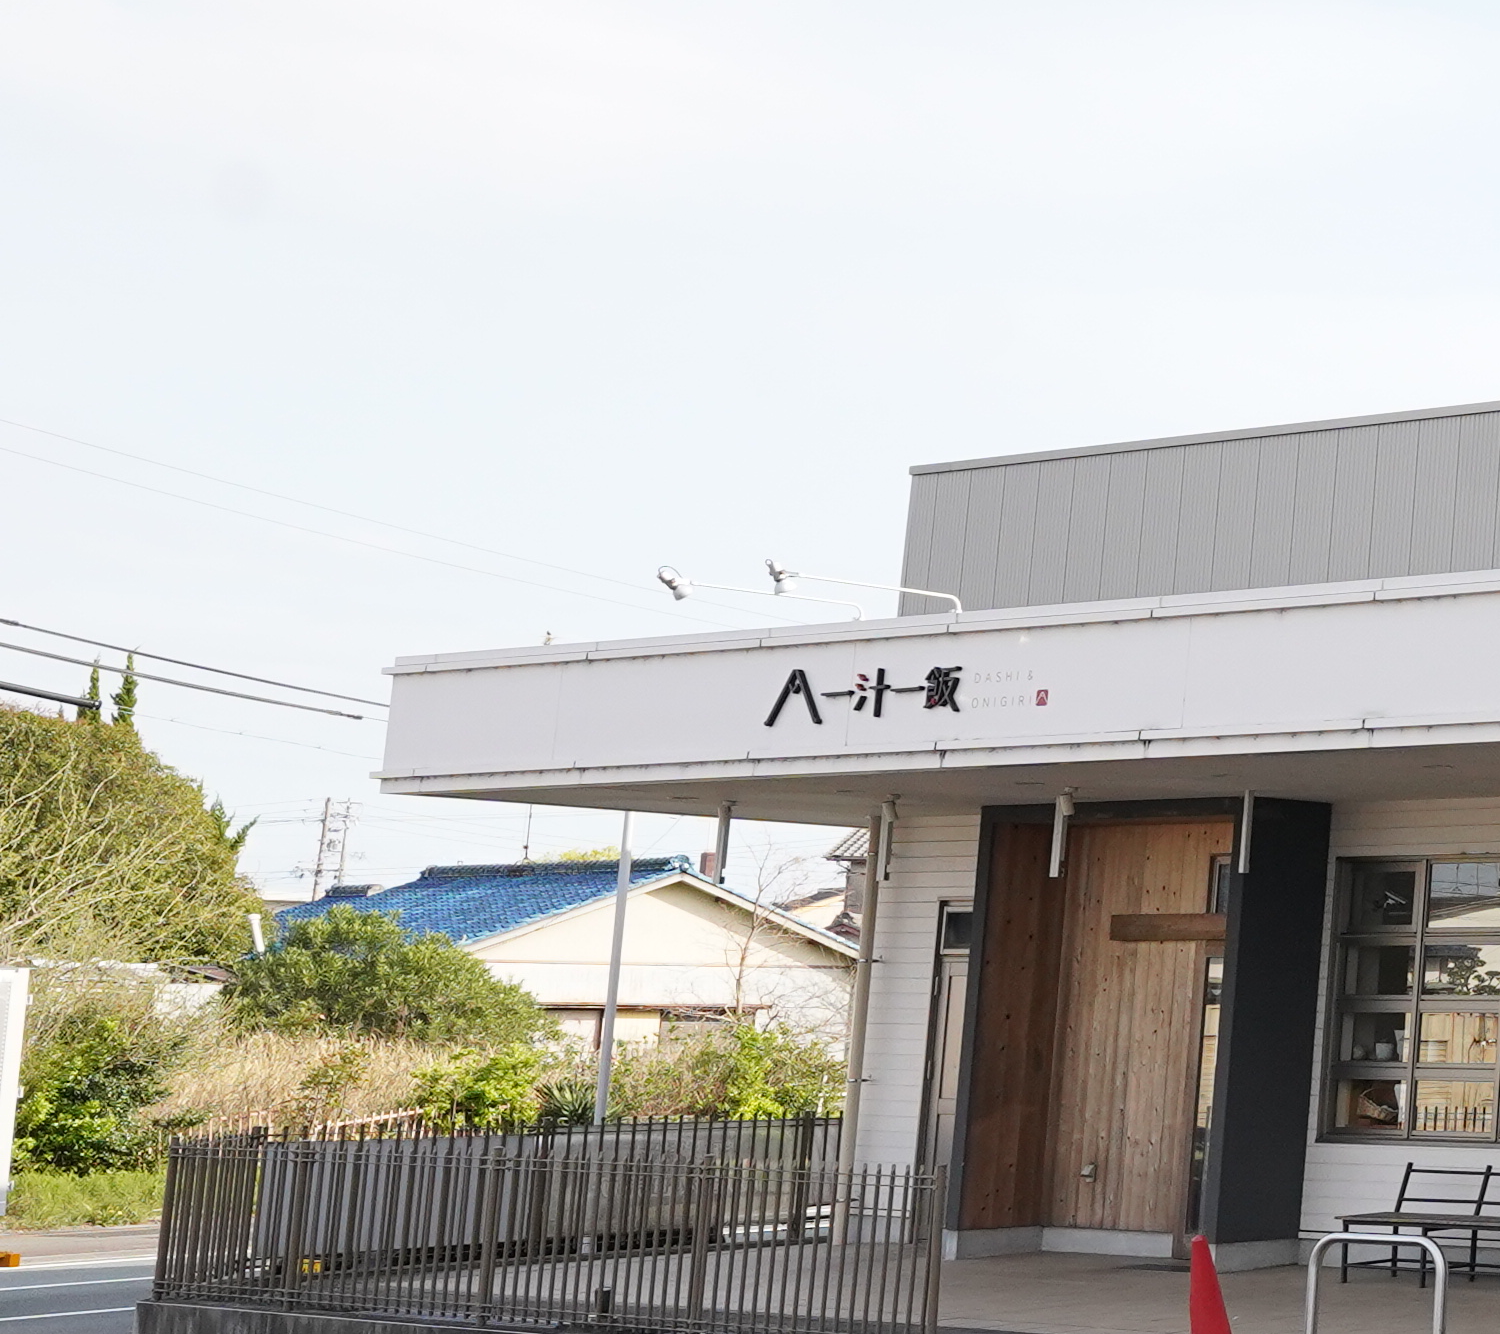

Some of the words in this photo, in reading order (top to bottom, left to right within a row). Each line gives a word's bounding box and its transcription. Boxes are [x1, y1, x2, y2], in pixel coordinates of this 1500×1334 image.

[973, 670, 1021, 684] DASHI
[1027, 670, 1034, 681] &
[820, 665, 963, 718] 一汁一飯
[971, 694, 1034, 709] ONIGIRI
